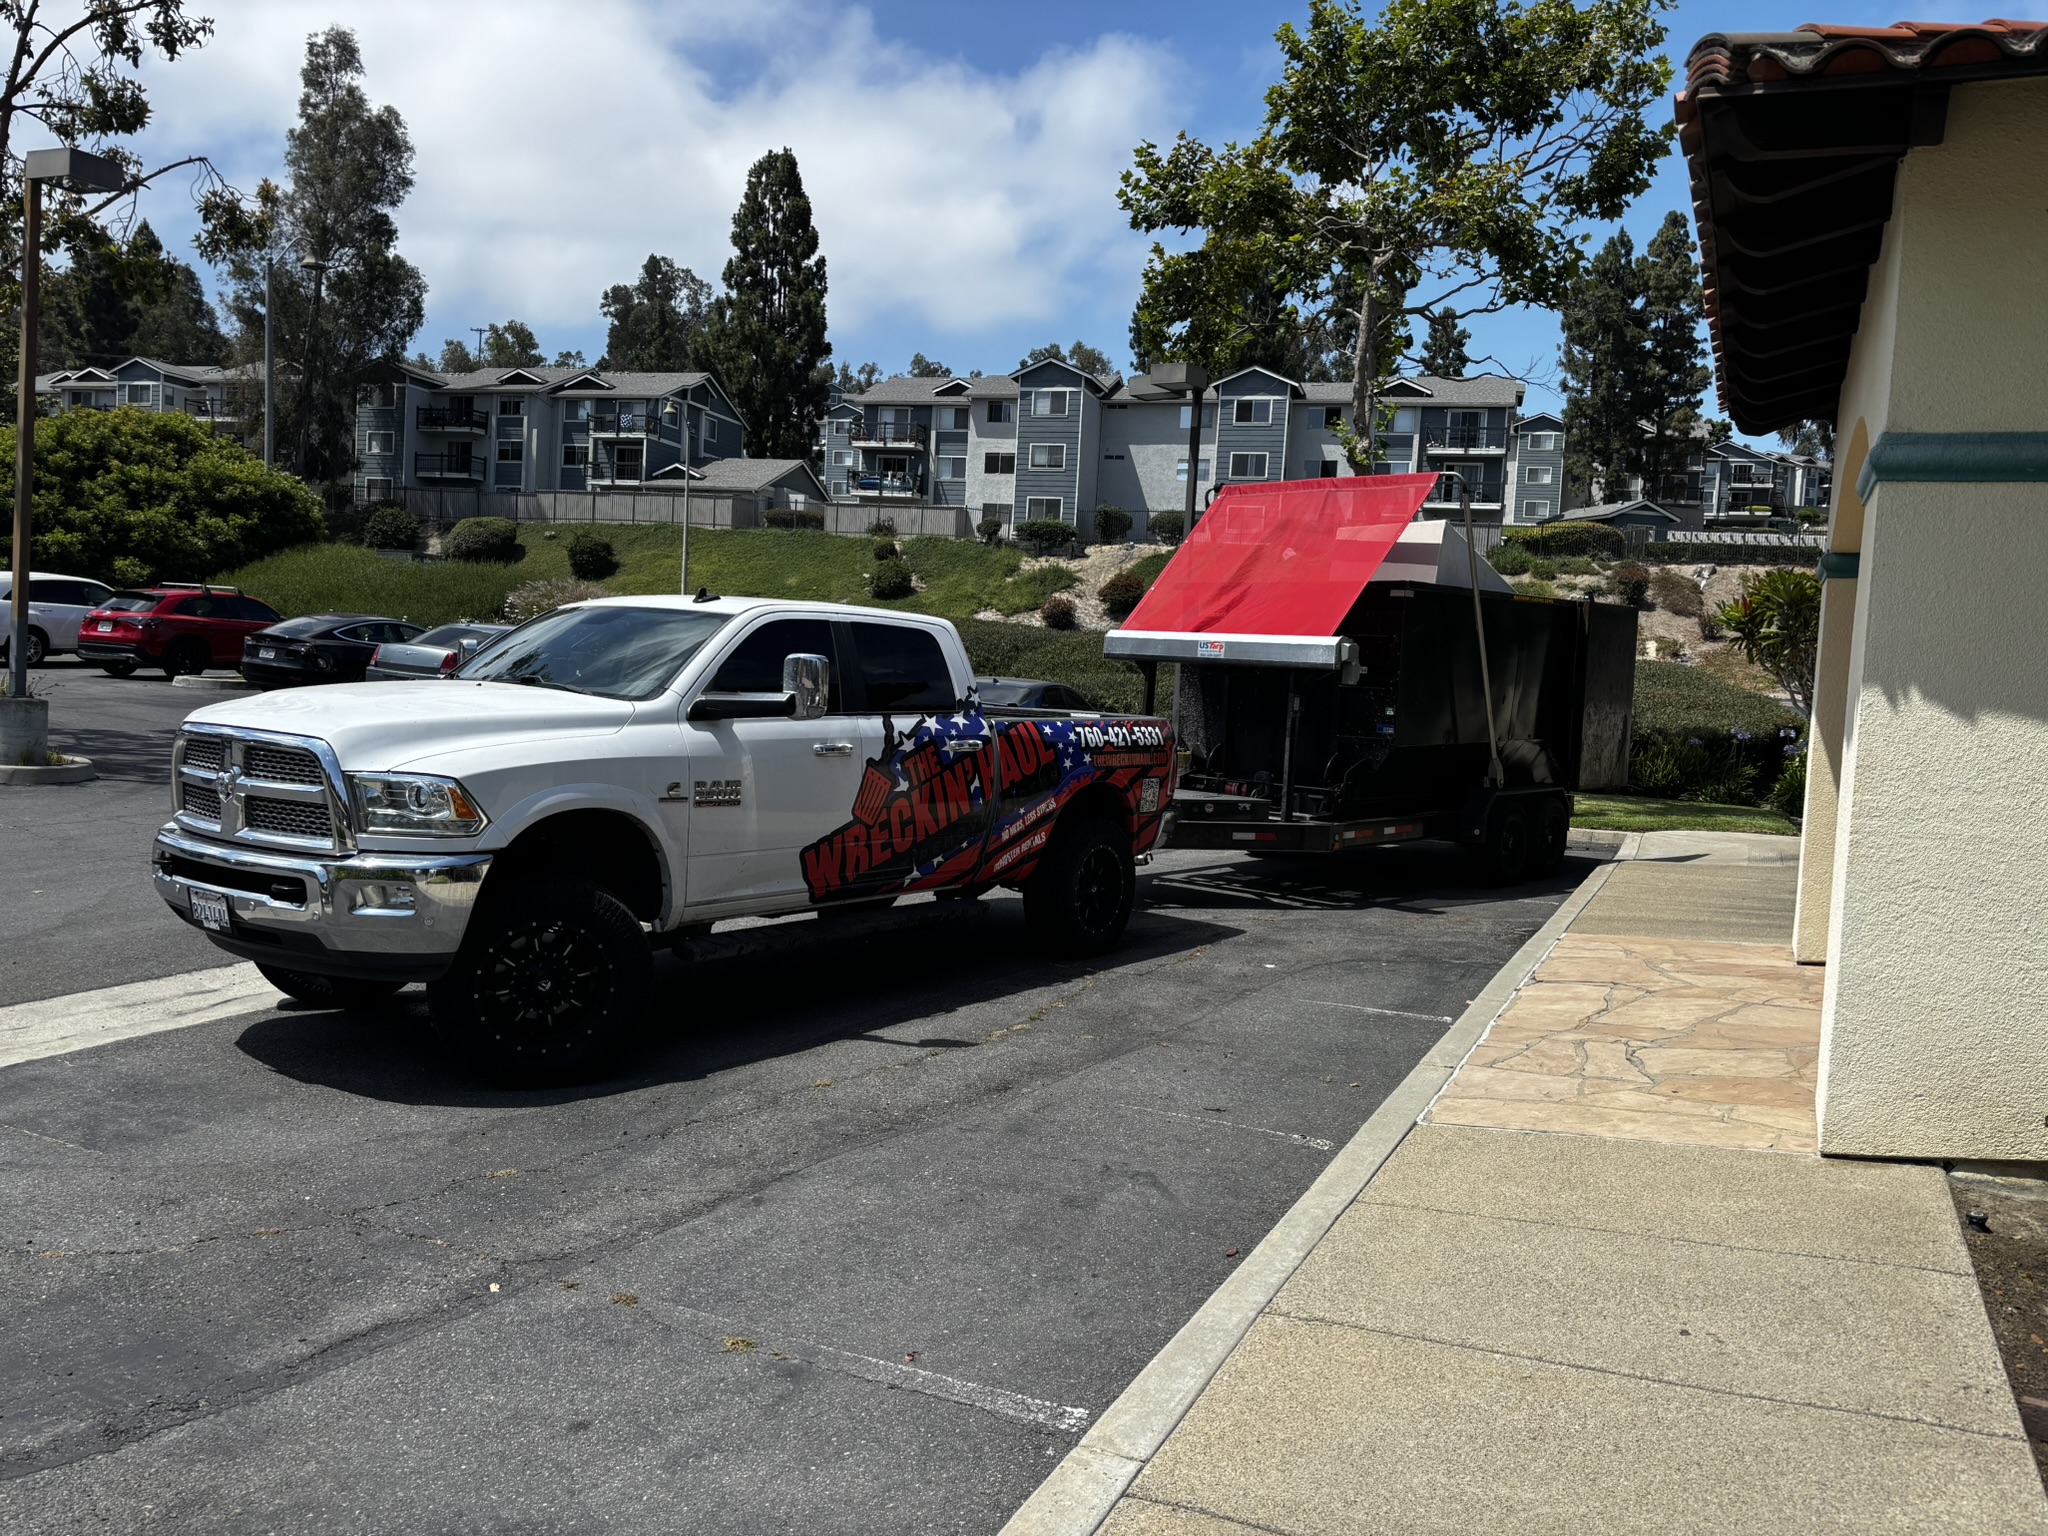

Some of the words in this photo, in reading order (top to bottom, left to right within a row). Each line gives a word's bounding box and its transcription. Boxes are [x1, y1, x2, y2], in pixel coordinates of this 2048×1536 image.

[1074, 726, 1165, 748] 760-421-5331
[904, 745, 941, 786] THE
[1092, 752, 1167, 767] THEWRECKINHAUL.COM
[694, 780, 742, 790] RAM
[694, 790, 742, 800] 2500
[804, 757, 974, 899] WRECKIN'
[977, 721, 1056, 801] HAUL
[1001, 828, 1010, 842] NO
[1025, 809, 1037, 825] LESS
[993, 847, 1020, 872] DUMPSTER
[1021, 832, 1046, 852] RENTALS
